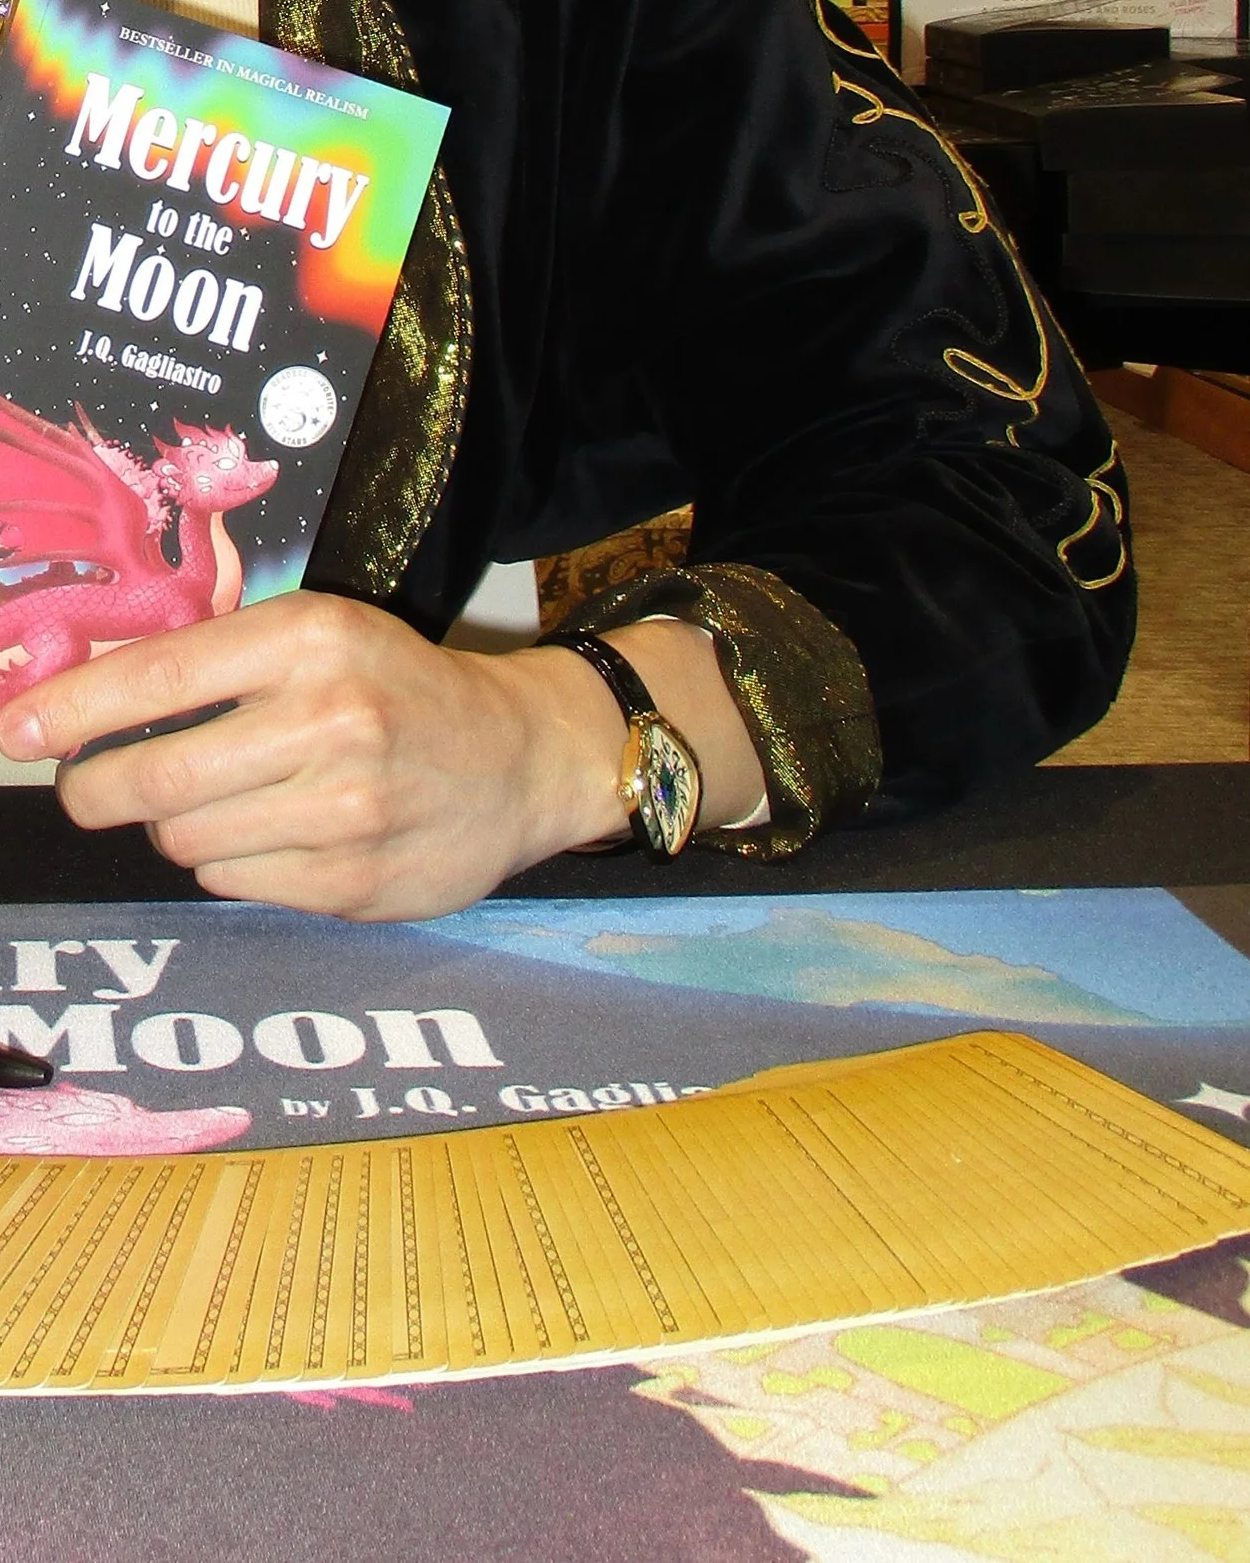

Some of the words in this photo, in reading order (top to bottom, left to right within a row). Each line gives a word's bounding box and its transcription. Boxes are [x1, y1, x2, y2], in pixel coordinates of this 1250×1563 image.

[1121, 5, 1156, 15] ROSES
[119, 25, 214, 67] BESTSELLER
[216, 58, 235, 74] IN
[237, 65, 303, 98] MAGICAL
[305, 88, 370, 121] REALISM
[63, 71, 371, 250] Mercury
[146, 198, 179, 238] to
[187, 209, 234, 256] the
[70, 223, 264, 353] Moon
[76, 329, 116, 362] J.Q.
[121, 343, 224, 396] Gagliastro
[281, 1096, 332, 1120] by
[352, 1087, 478, 1119] J.Q.
